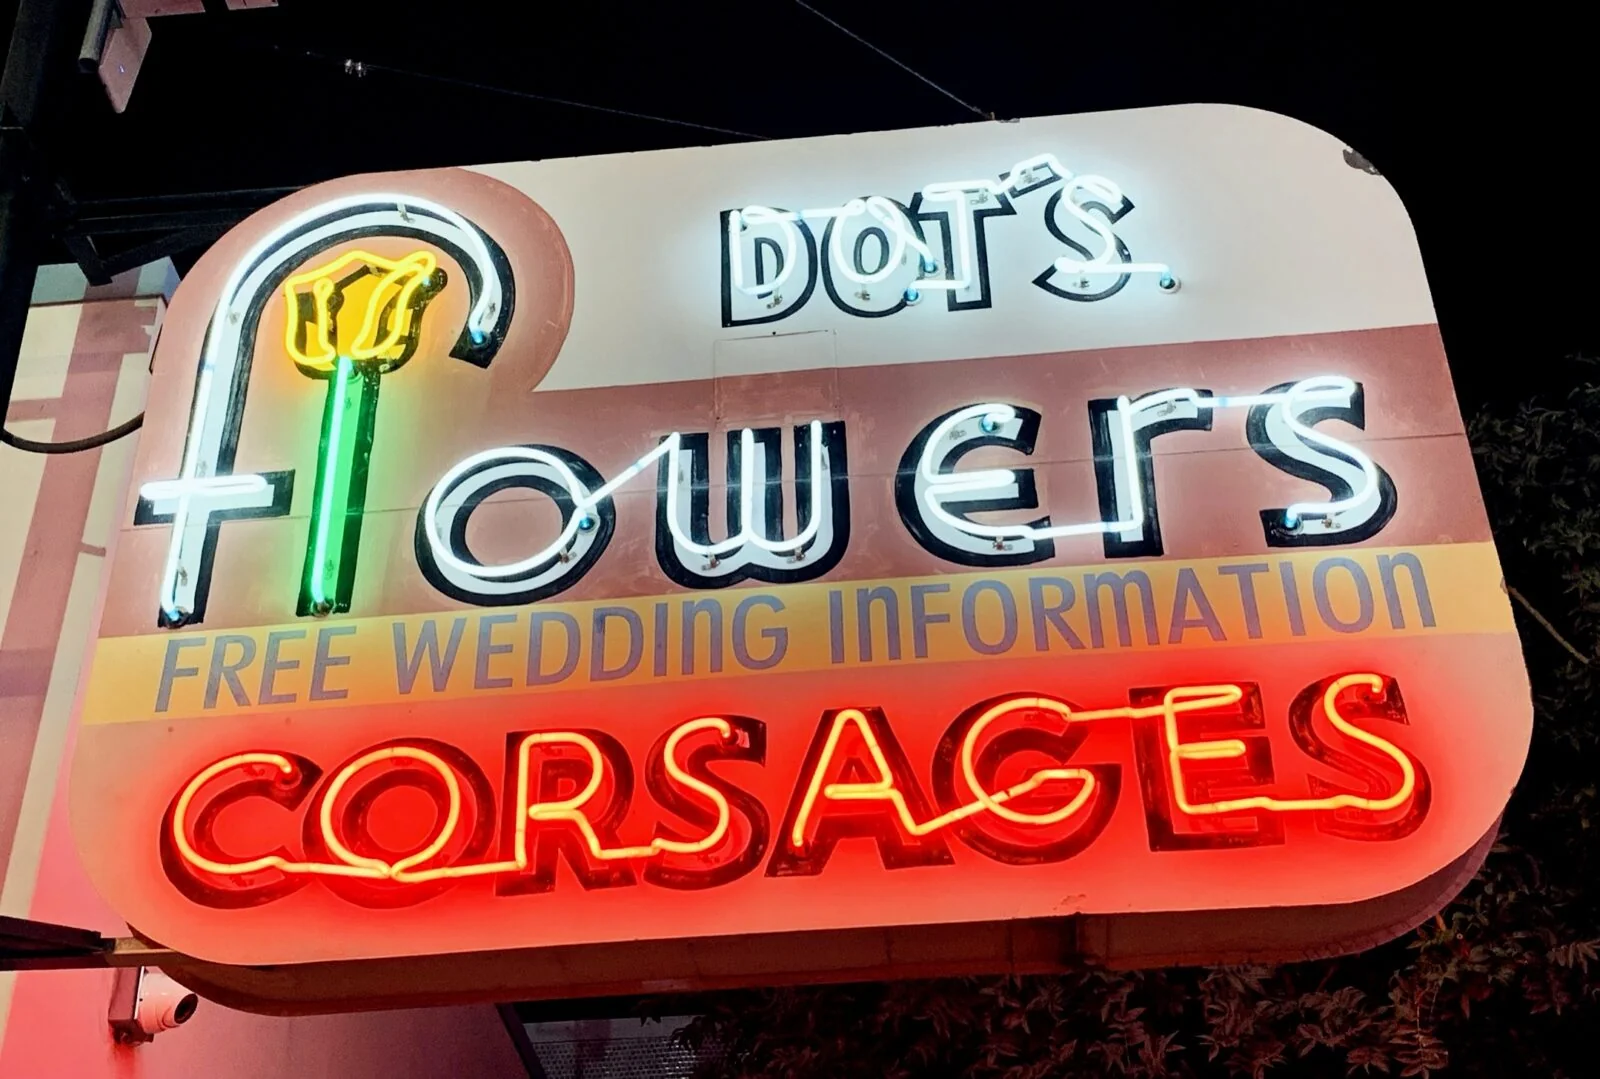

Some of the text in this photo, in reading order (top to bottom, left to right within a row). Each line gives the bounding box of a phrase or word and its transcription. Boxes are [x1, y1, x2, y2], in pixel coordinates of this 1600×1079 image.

[718, 153, 1136, 328] DOT'S
[154, 627, 354, 713] FREE
[159, 673, 1432, 908] CORSAGES
